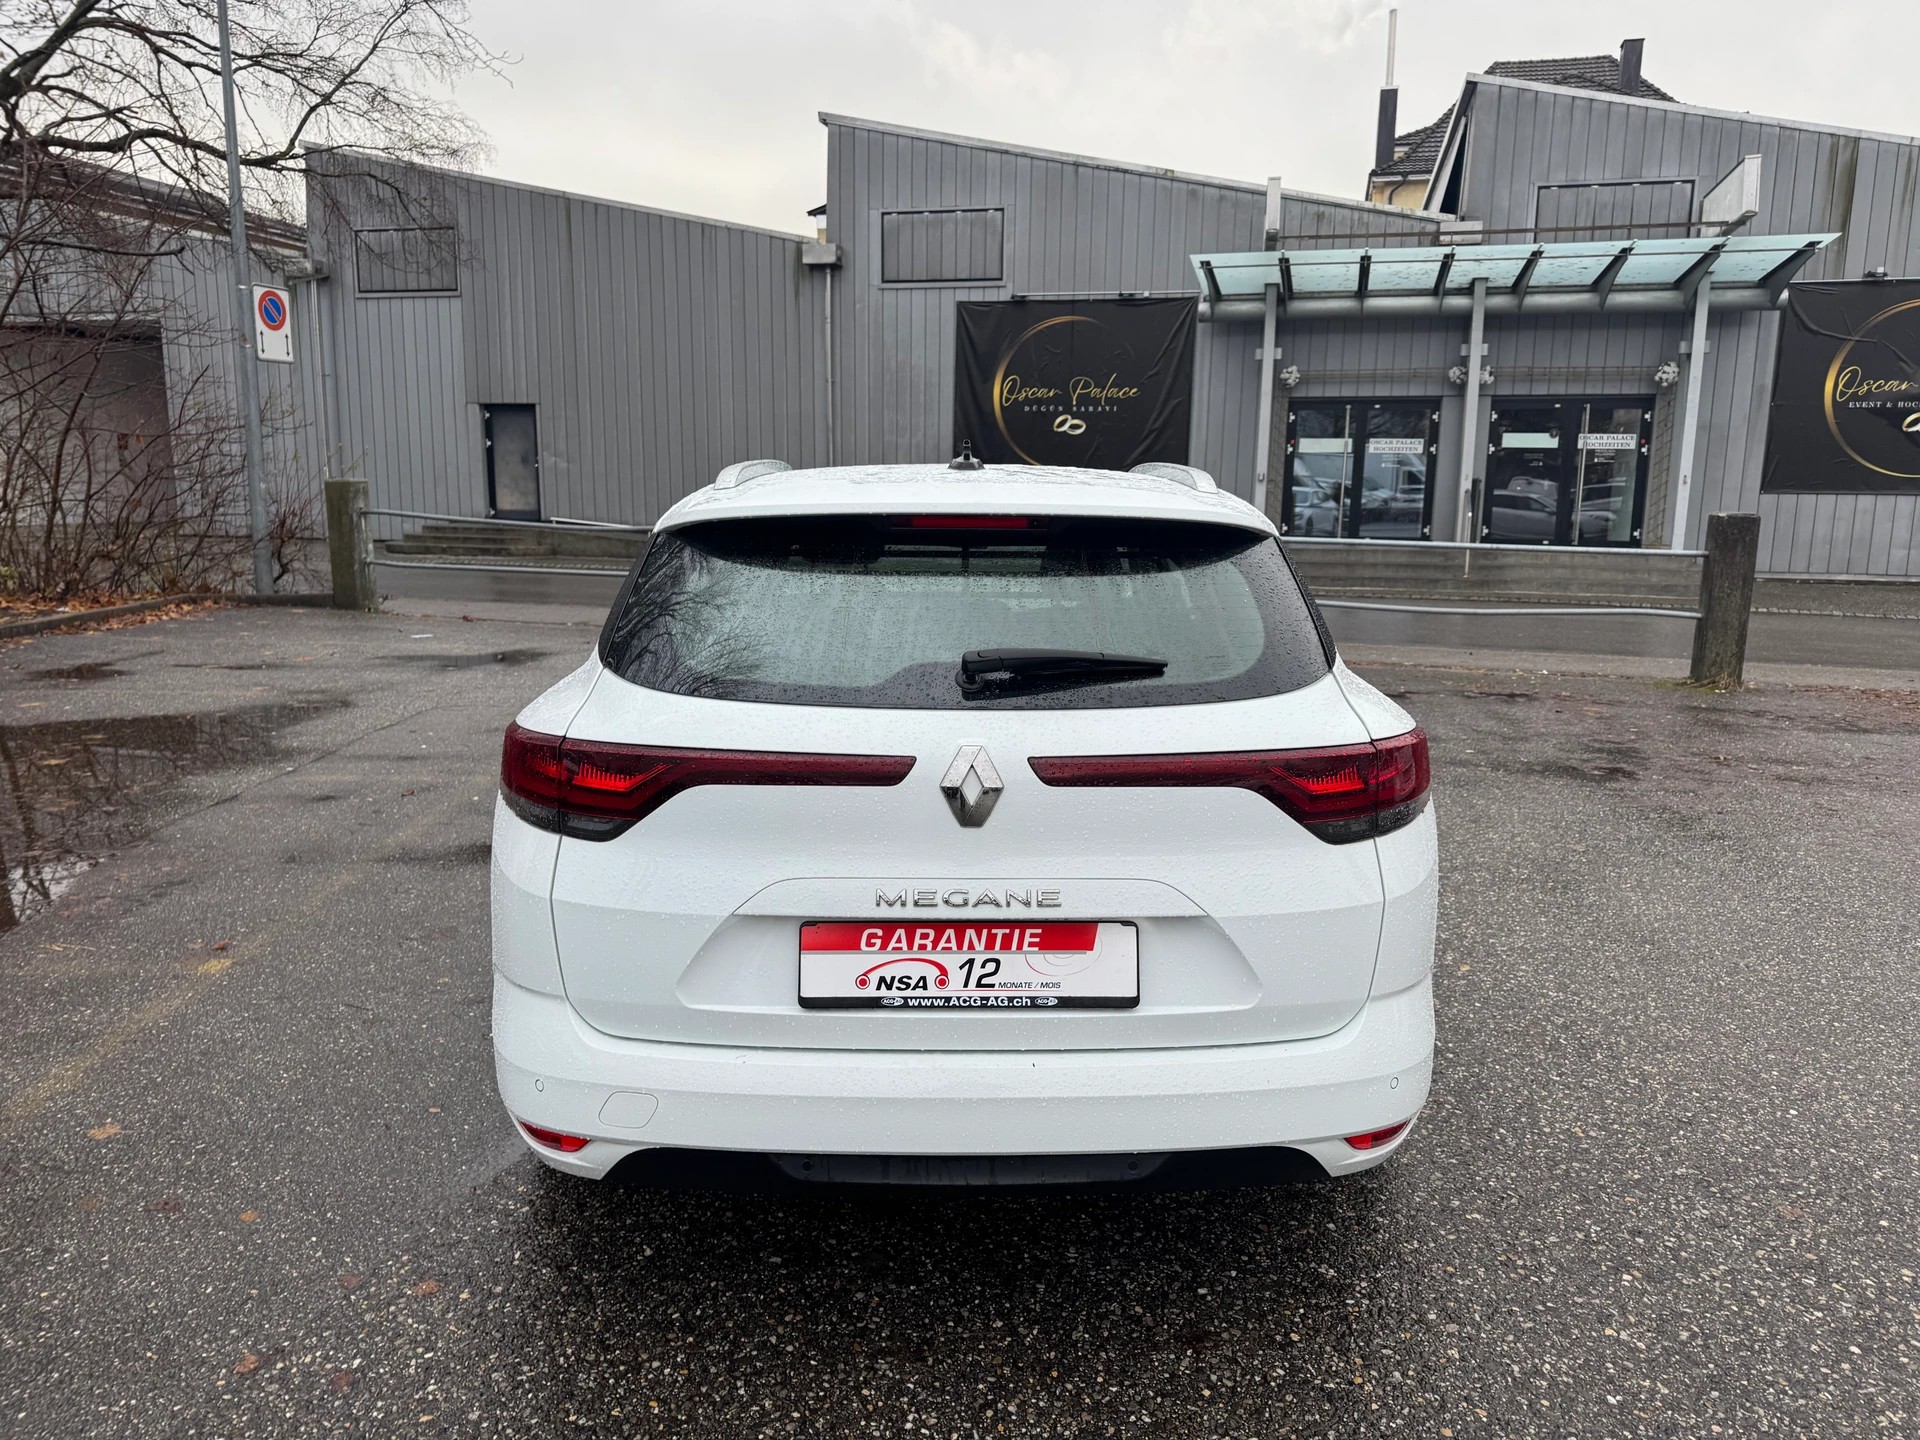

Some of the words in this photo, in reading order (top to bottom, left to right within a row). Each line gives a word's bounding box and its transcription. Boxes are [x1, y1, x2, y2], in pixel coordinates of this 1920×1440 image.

[1002, 375, 1062, 406] Oscar
[1069, 373, 1140, 405] Palace
[1836, 366, 1919, 401] Oscar
[876, 888, 1062, 908] MEGANE
[860, 928, 1043, 951] GARANTIE
[875, 975, 929, 991] NSA
[958, 957, 1001, 989] 12
[907, 996, 1031, 1007] www.ACG-AG.ch
